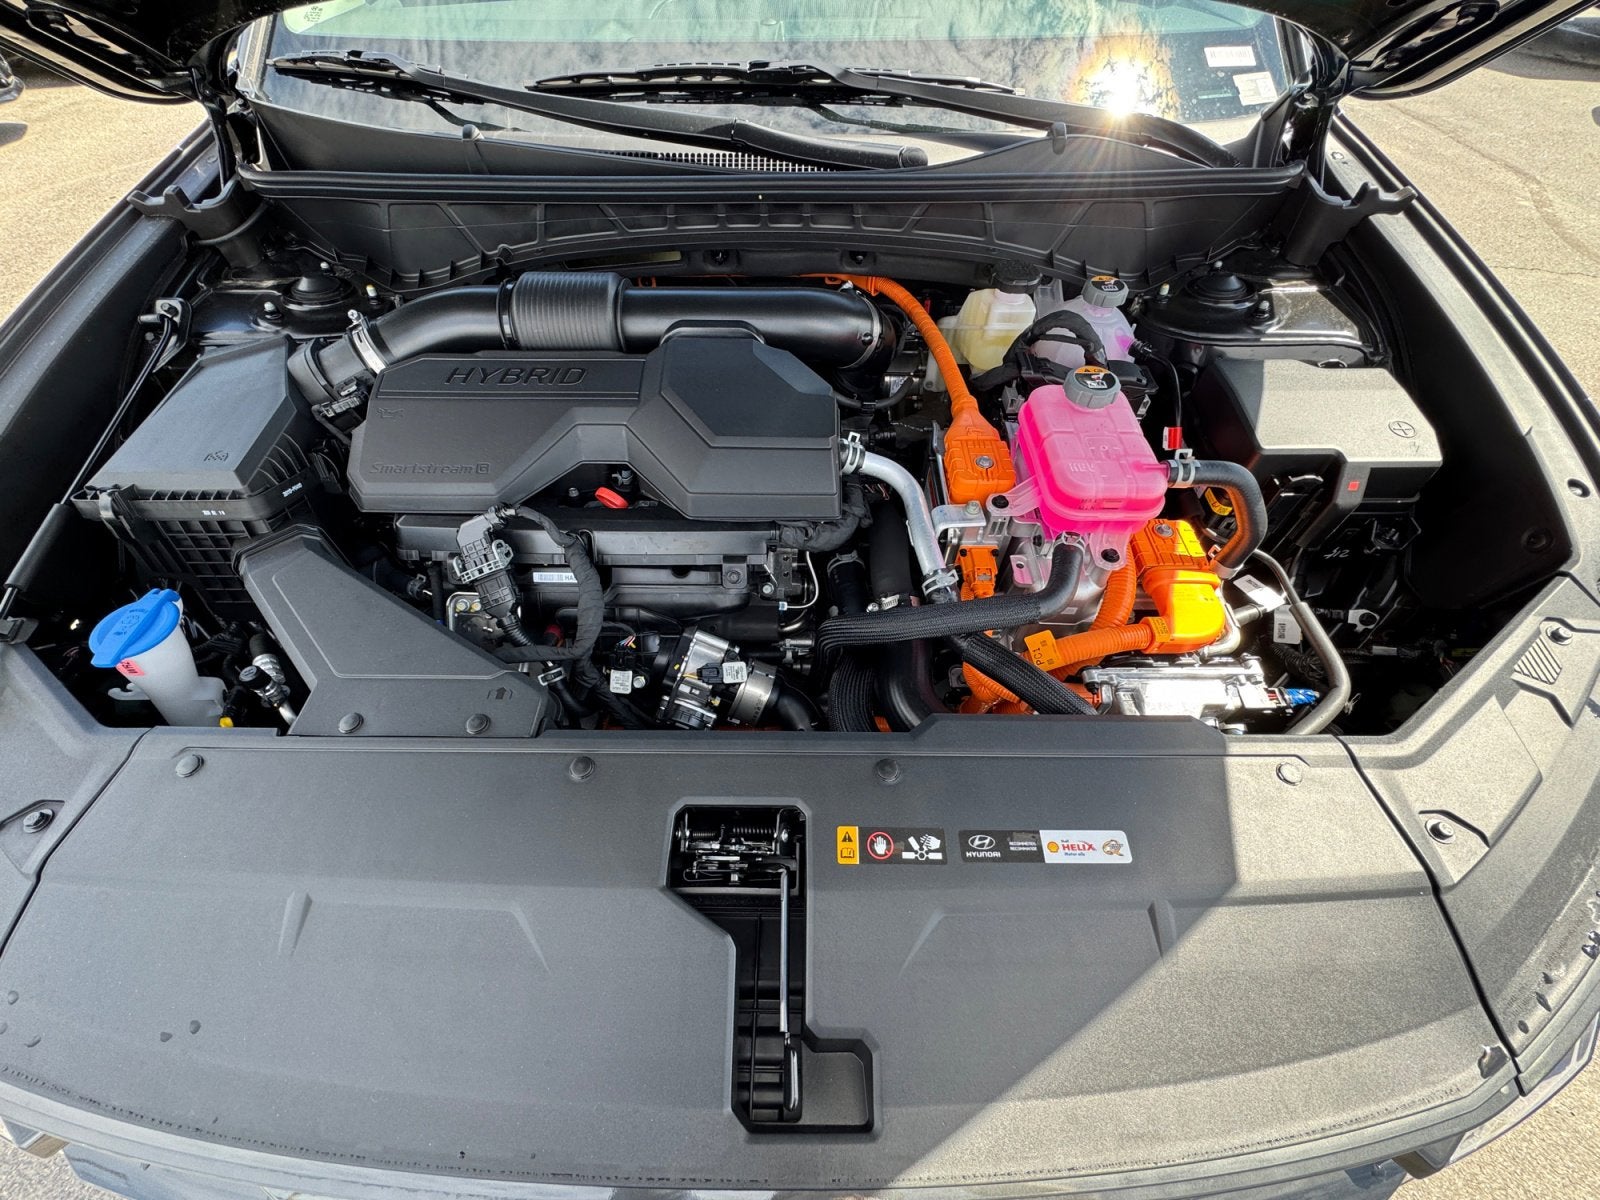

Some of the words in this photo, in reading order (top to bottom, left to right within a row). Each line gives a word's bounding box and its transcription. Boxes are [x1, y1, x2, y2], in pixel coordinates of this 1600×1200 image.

[444, 367, 588, 386] HYBRID
[369, 461, 475, 474] Smartstream
[1033, 646, 1045, 667] PC1
[1061, 842, 1096, 852] HELIX
